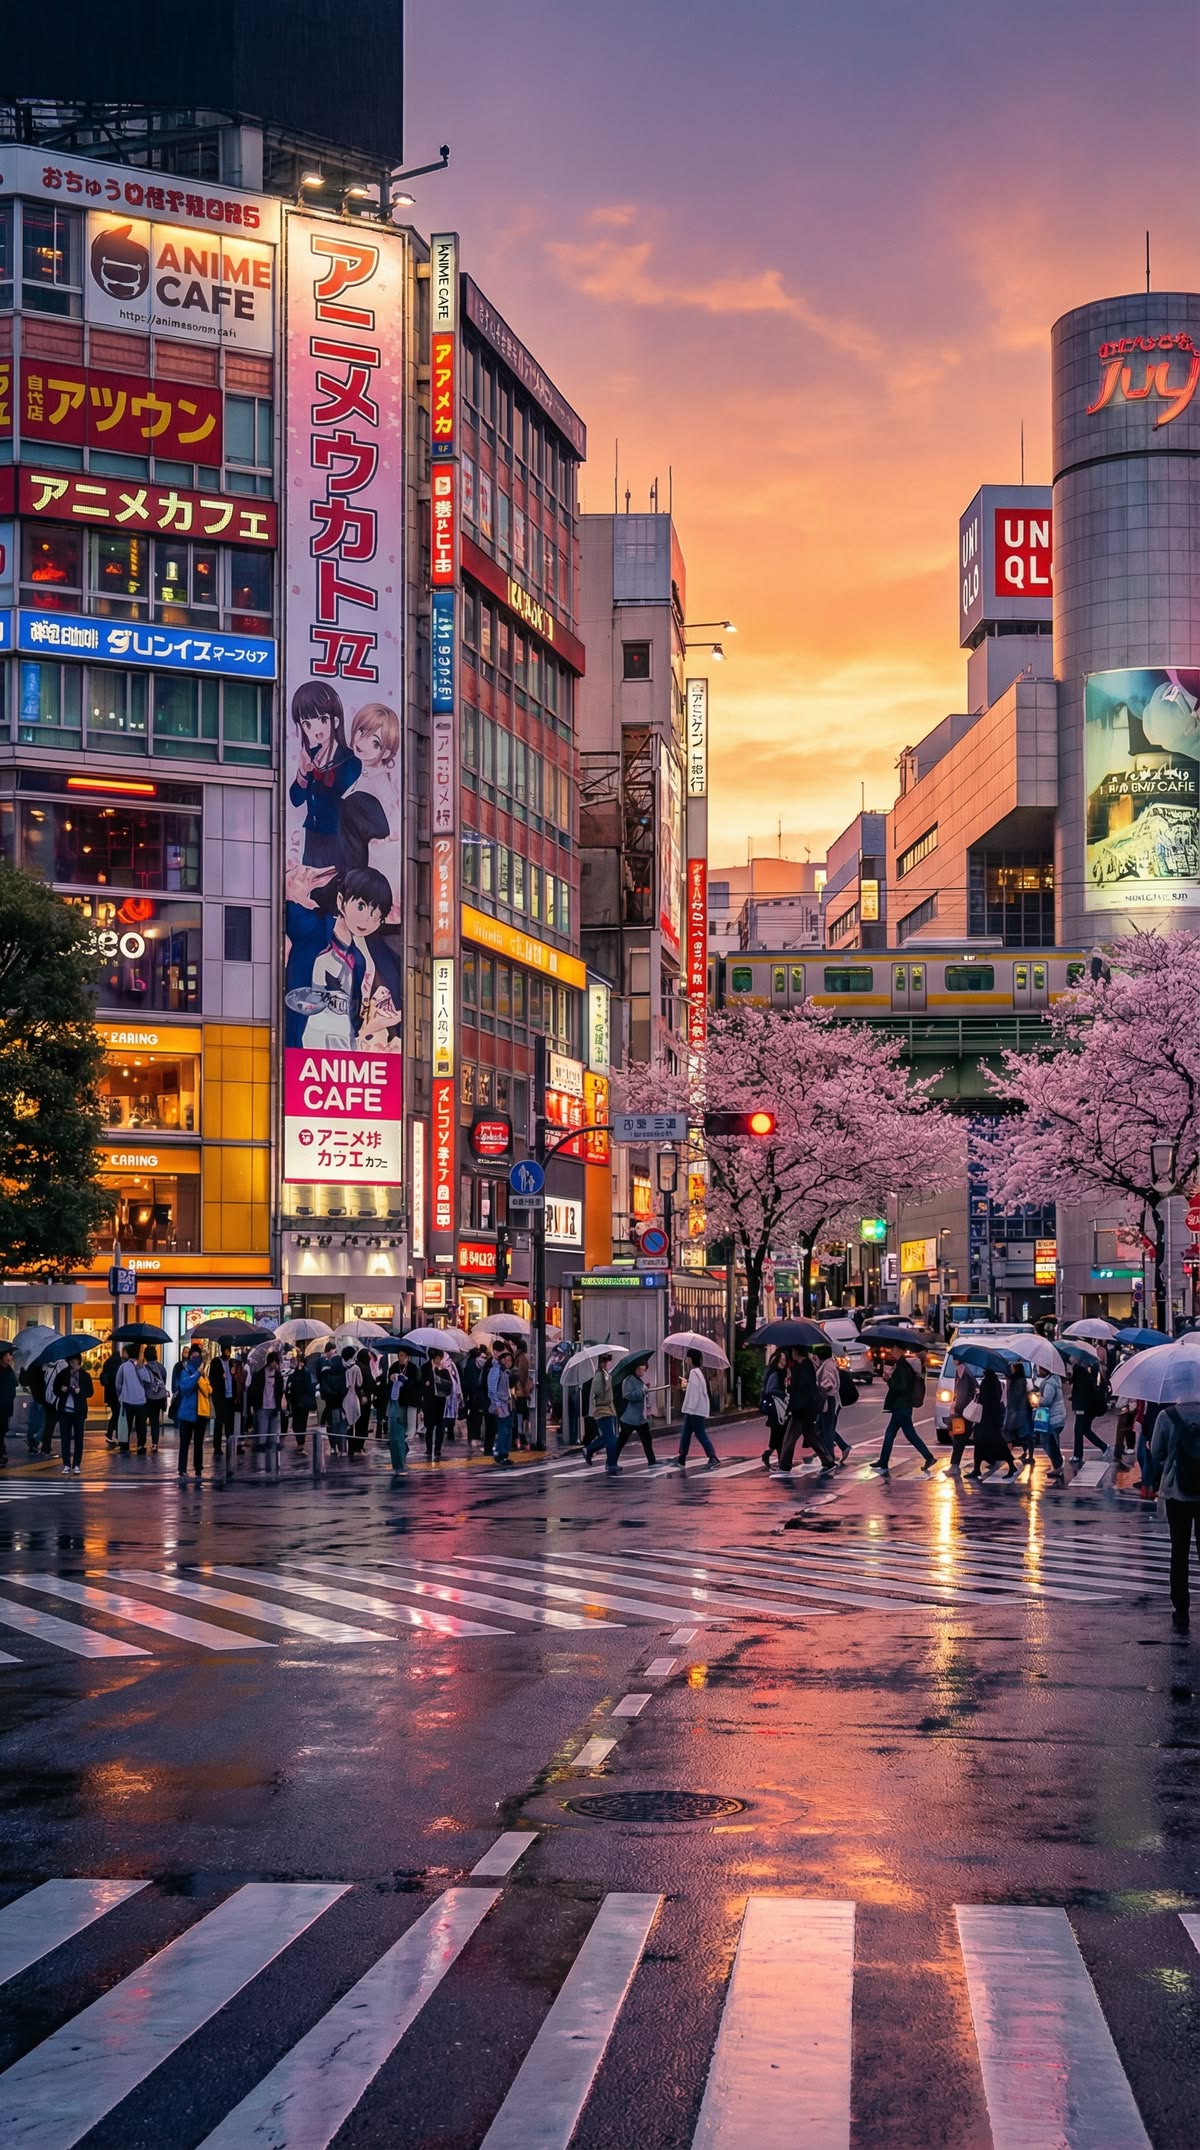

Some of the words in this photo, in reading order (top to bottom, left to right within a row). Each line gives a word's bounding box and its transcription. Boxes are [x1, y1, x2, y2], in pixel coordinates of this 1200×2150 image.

[156, 243, 272, 290] ANIME
[155, 275, 256, 322] CAFE
[437, 288, 449, 320] CAFE
[47, 378, 217, 444] アツウン
[434, 343, 452, 434] アアメカ
[962, 517, 978, 569] UNI
[962, 564, 979, 616] QLO
[1004, 555, 1054, 589] QL
[299, 1057, 388, 1085] ANIME
[303, 1085, 382, 1112] CAFE
[111, 1154, 159, 1167] EARING
